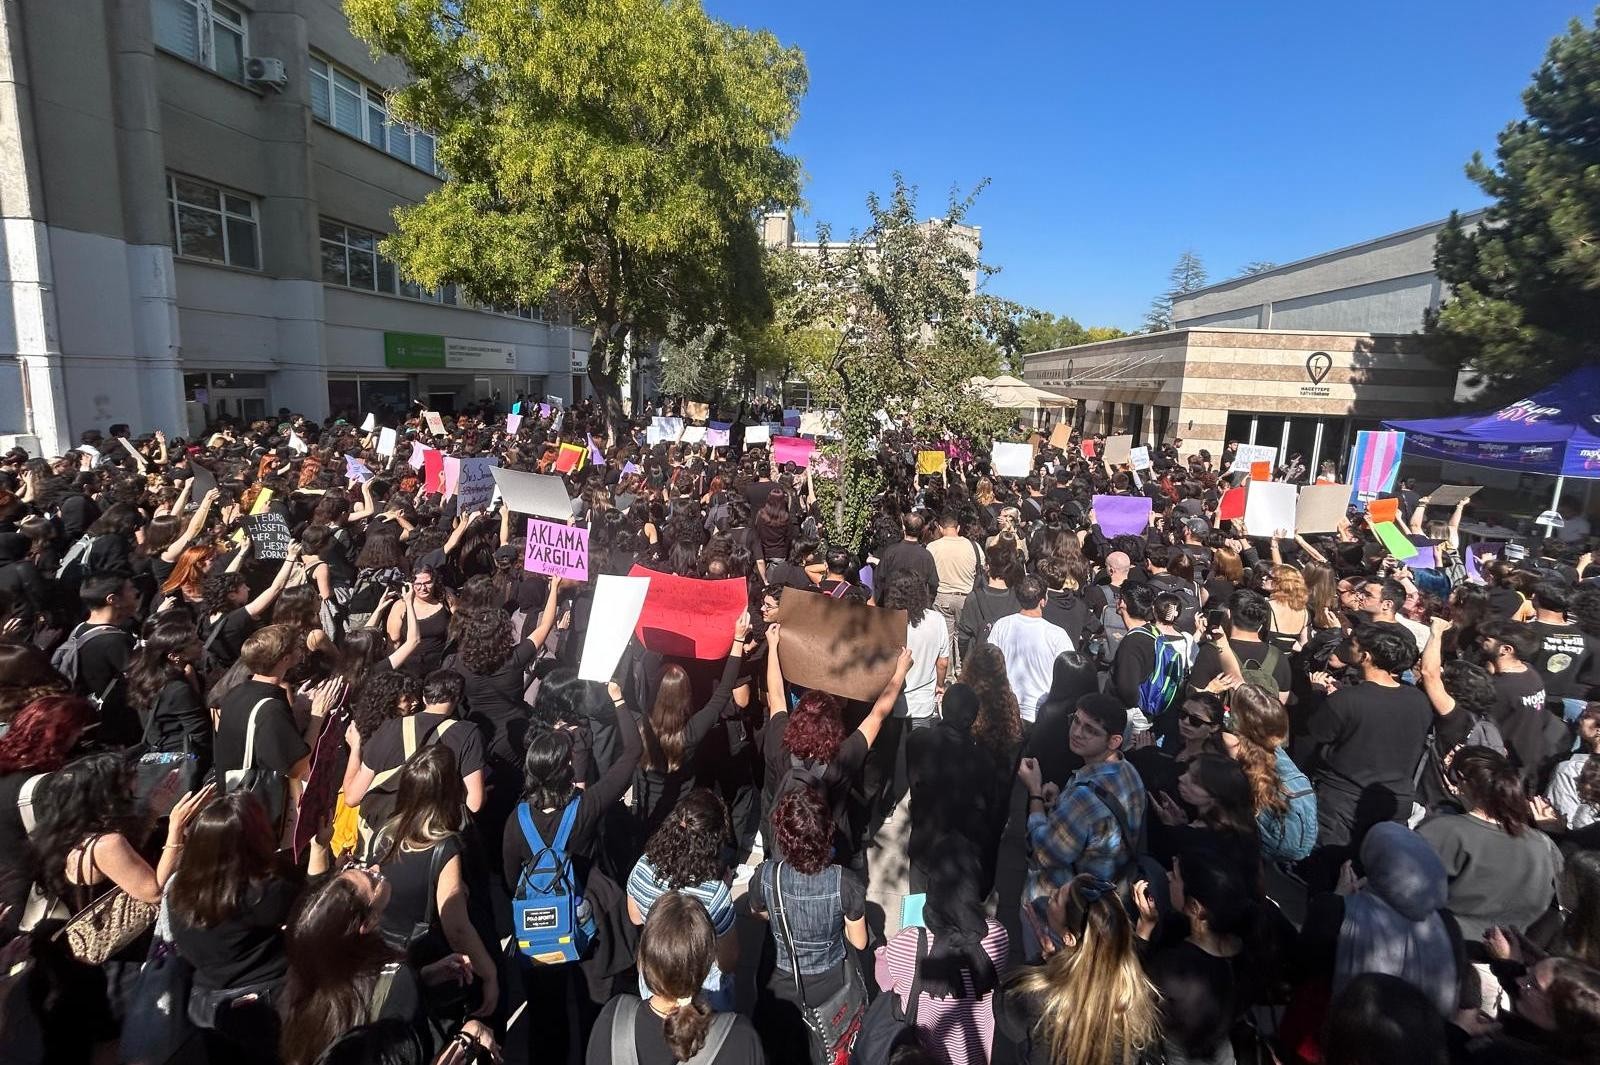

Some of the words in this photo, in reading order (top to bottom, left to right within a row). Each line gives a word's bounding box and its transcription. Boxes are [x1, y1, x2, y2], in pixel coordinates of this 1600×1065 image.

[251, 533, 271, 541] HER
[529, 523, 585, 553] AKLAMA
[528, 543, 586, 570] YARGILA
[1545, 636, 1562, 644] we
[1563, 638, 1584, 646] will
[1544, 642, 1557, 650] be
[1558, 644, 1584, 654] okay
